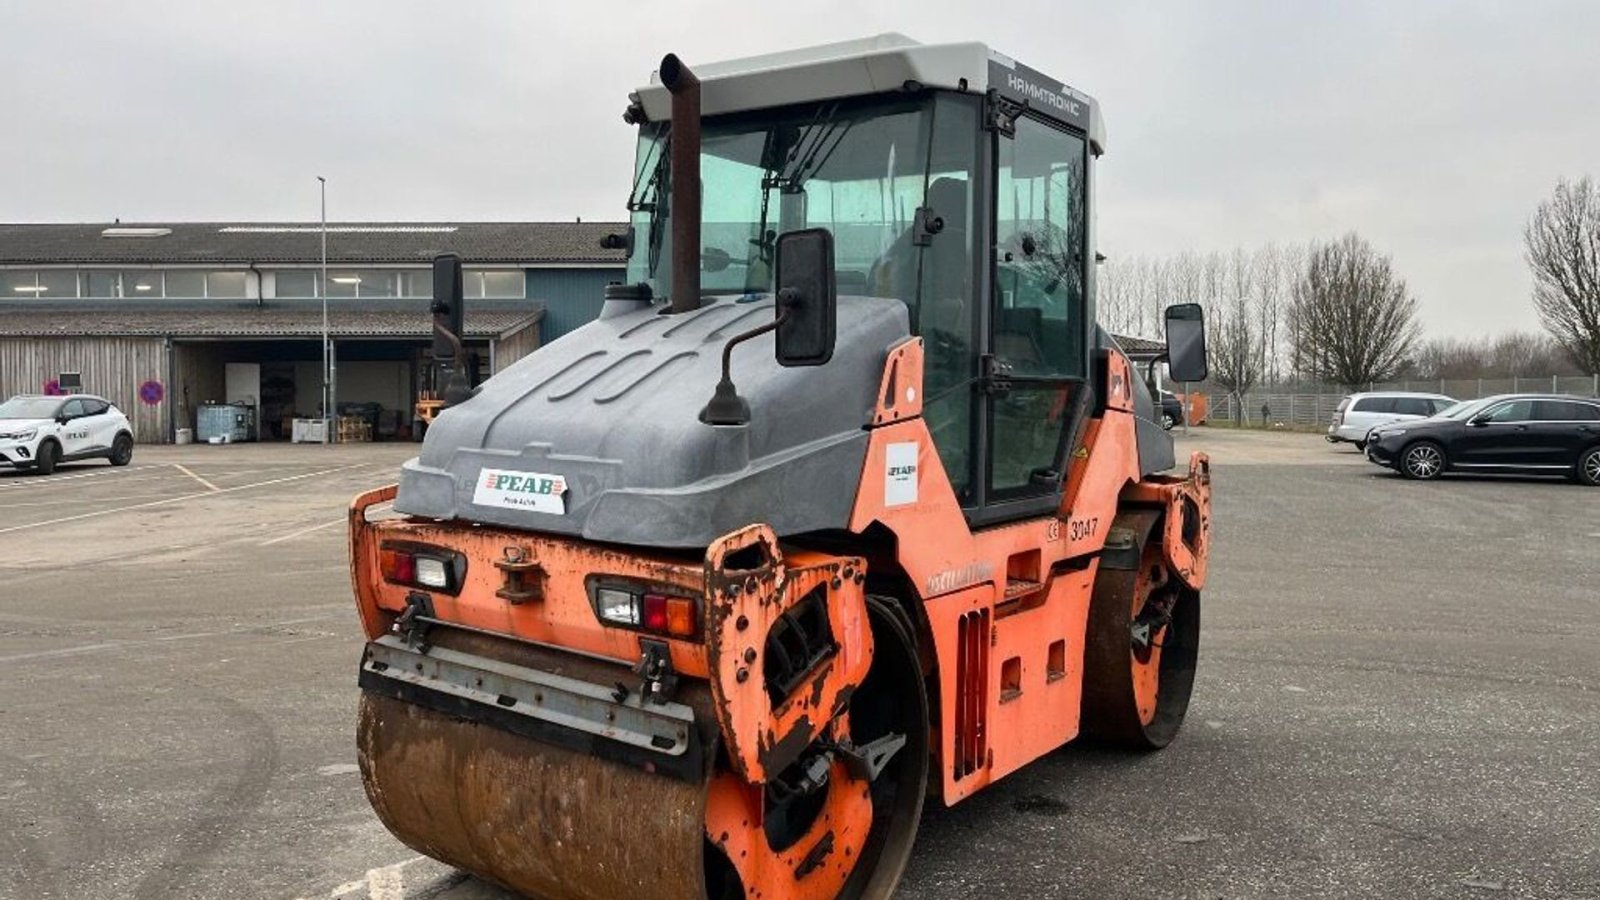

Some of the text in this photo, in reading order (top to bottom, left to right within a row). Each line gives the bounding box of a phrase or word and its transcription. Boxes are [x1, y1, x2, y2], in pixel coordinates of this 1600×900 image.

[1008, 73, 1080, 116] HAMMTRONIC
[495, 474, 553, 495] PEAB
[1070, 518, 1098, 541] 3047
